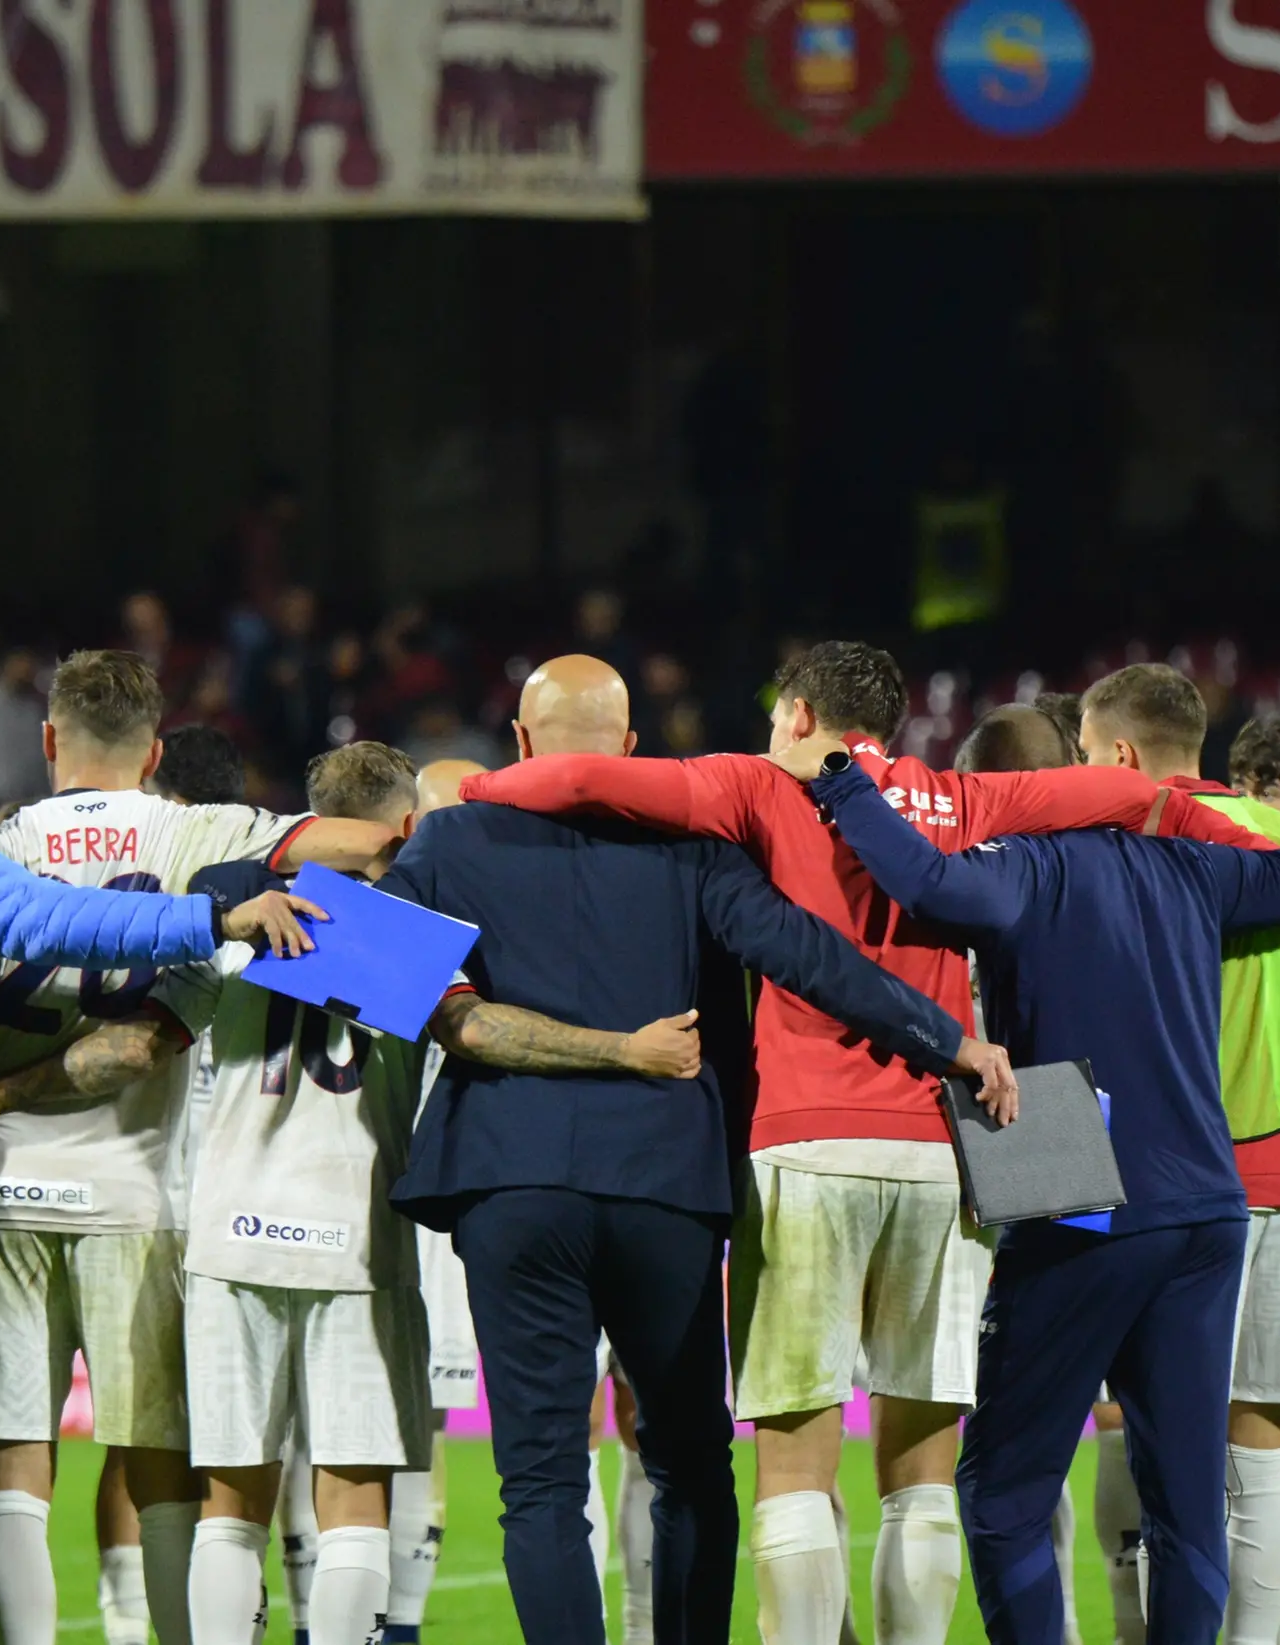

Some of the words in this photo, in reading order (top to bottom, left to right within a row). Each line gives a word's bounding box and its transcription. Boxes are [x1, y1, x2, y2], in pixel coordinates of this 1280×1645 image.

[881, 786, 954, 813] eus
[46, 826, 138, 865] BERRA
[0, 1184, 89, 1205] econet
[265, 1223, 346, 1247] econet
